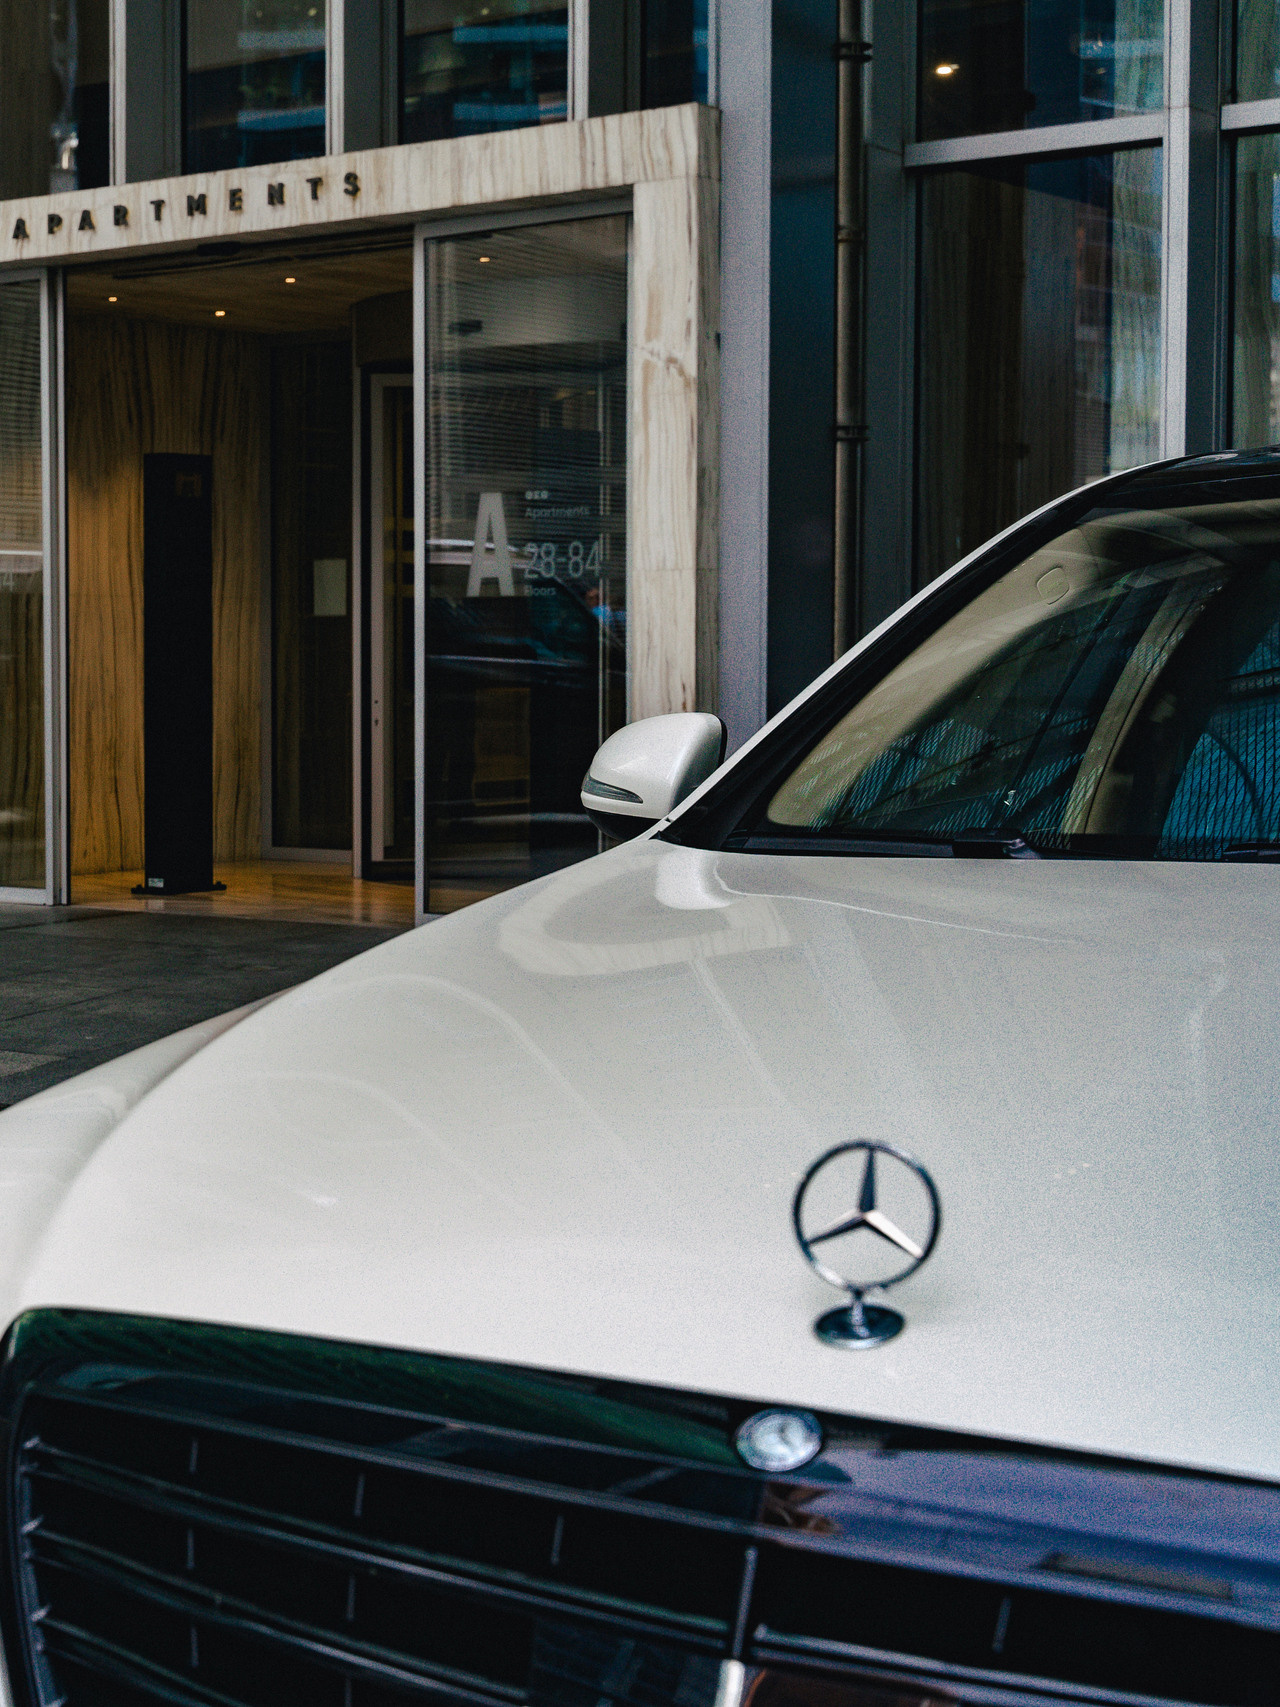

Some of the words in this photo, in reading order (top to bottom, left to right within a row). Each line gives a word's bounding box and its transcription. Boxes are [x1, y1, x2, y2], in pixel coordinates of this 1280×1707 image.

[12, 172, 361, 240] APARTMENTS
[525, 507, 590, 520] Apartments
[466, 492, 515, 597] A
[524, 541, 601, 578] 28-84
